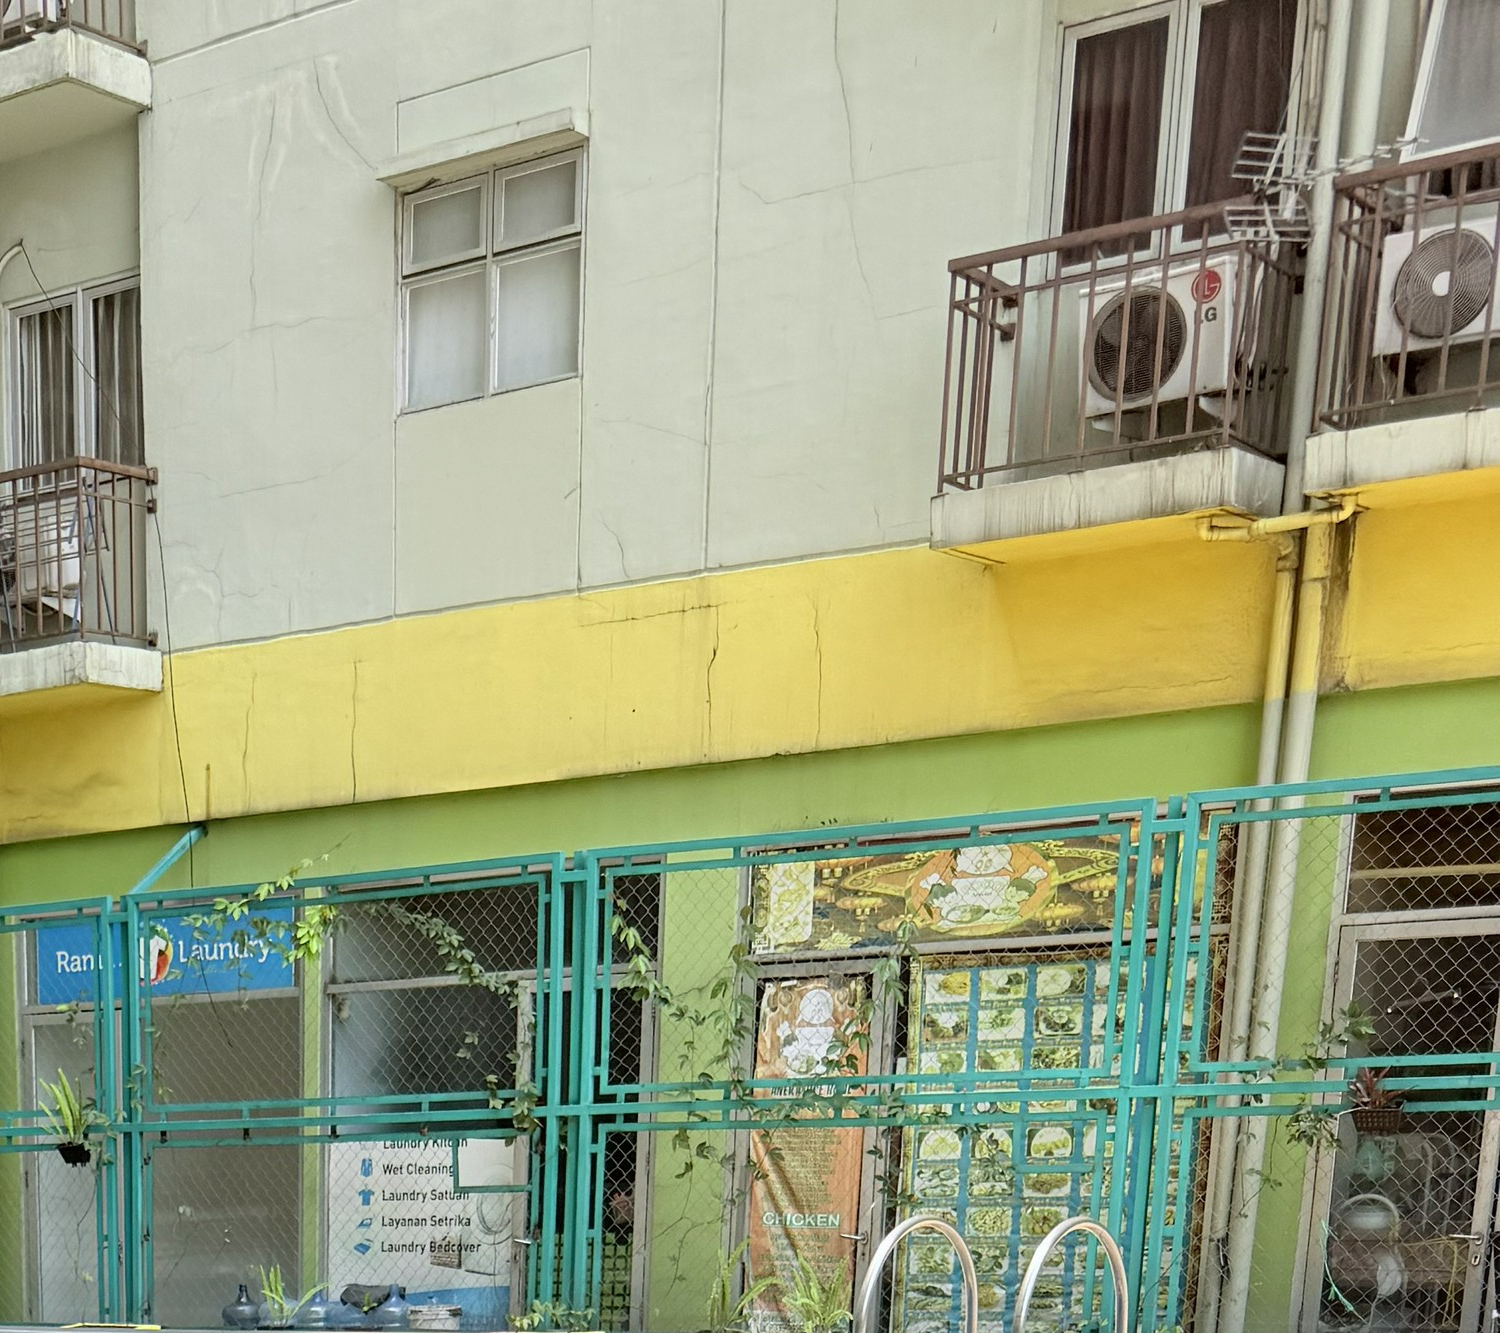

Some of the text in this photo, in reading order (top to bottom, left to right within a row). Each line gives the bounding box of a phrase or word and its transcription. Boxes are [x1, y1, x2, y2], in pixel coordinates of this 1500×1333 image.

[1197, 307, 1217, 323] G
[179, 938, 272, 964] Laundry
[382, 1162, 453, 1177] Wet Cleaning
[382, 1189, 470, 1203] Laundry Satuan
[381, 1214, 471, 1229] Layanan Setrika
[762, 1211, 840, 1227] CHICKEN
[381, 1241, 481, 1255] Laundry Bedcover
